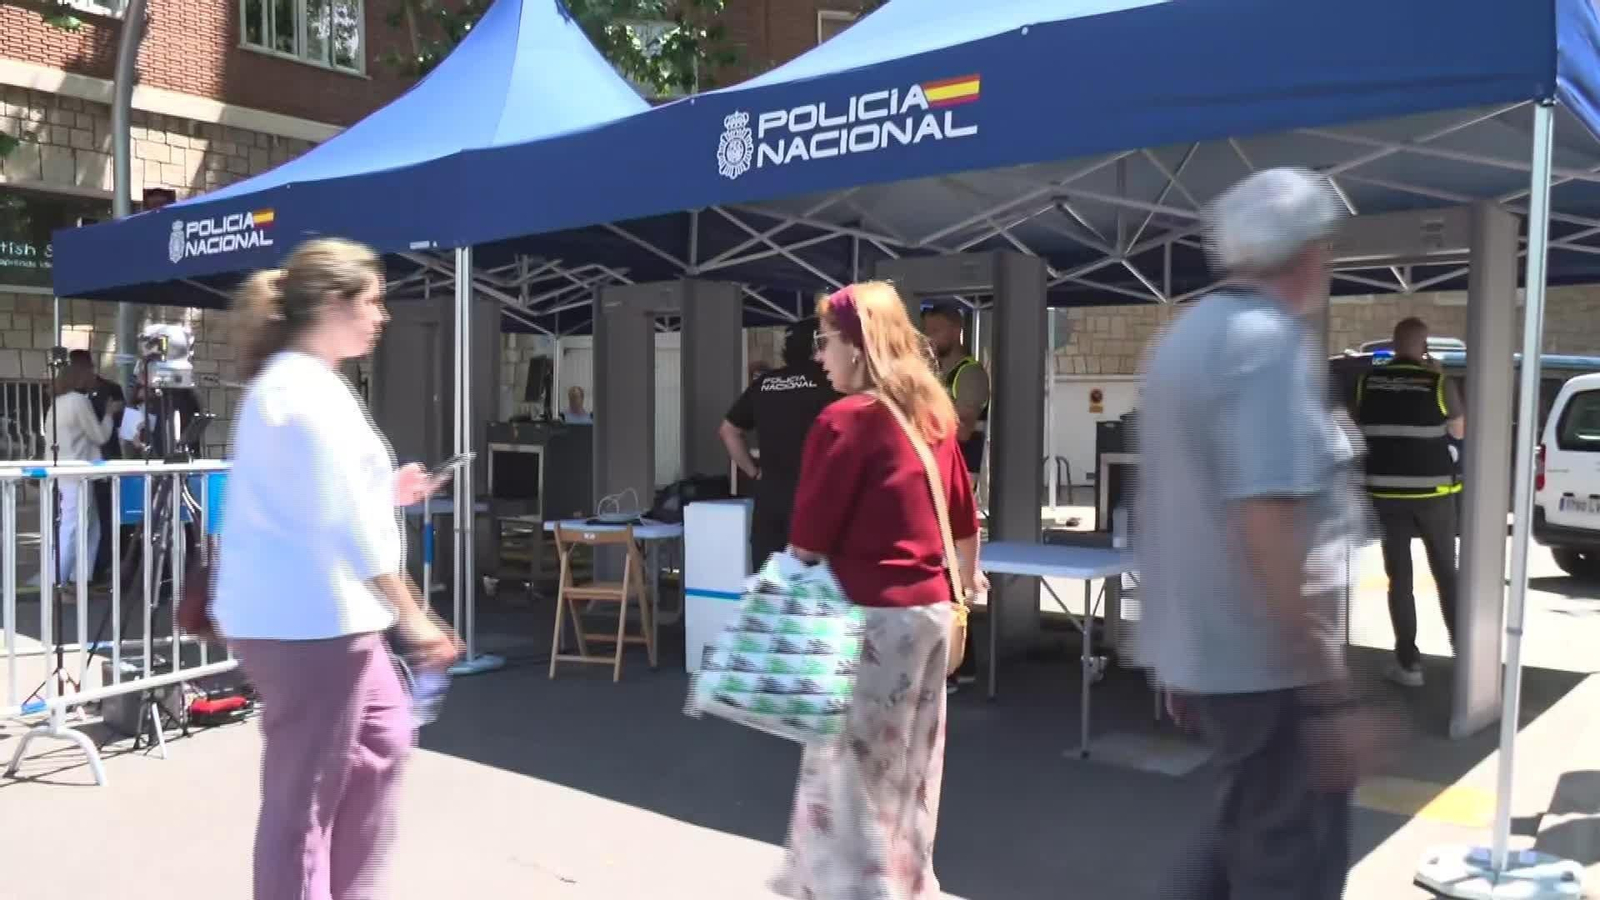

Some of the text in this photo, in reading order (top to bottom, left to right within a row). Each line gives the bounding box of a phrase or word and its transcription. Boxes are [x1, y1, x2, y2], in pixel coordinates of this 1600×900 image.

[758, 84, 929, 139] POLICIA
[757, 111, 978, 169] NACIONAL
[186, 211, 255, 239] POLICIA
[185, 229, 274, 258] NACIONAL
[761, 380, 817, 391] NACIONAL
[762, 375, 806, 385] POLICIA
